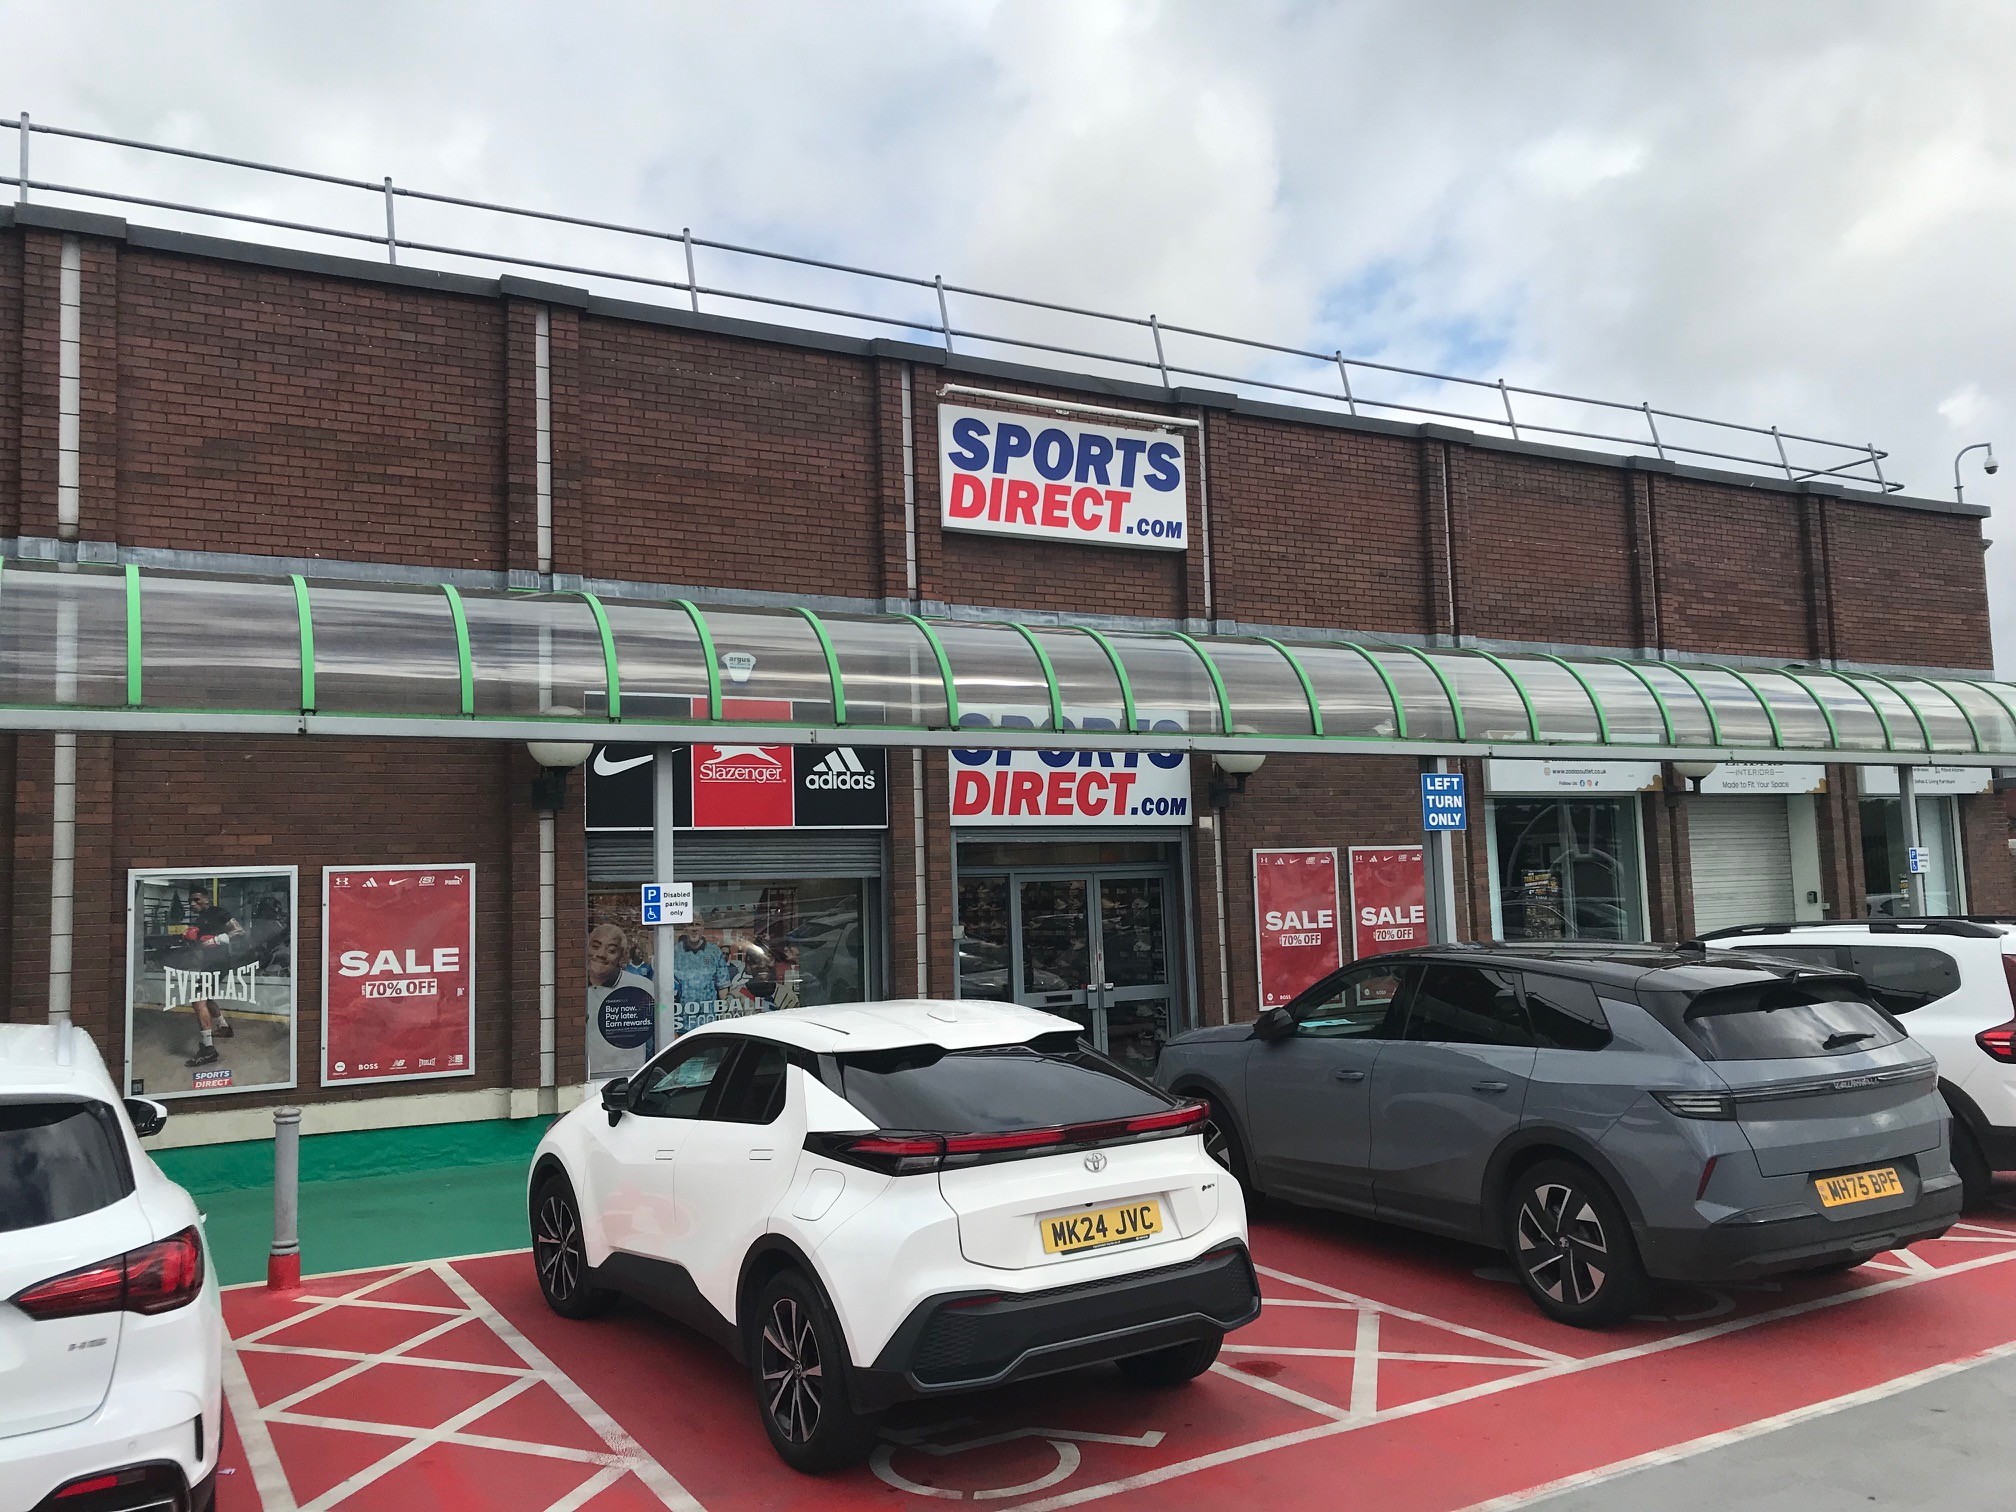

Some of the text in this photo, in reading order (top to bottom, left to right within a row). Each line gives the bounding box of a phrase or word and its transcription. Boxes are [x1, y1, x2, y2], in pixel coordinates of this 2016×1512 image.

[948, 418, 1182, 492] SPORTS
[700, 764, 782, 783] Slazenger
[805, 771, 876, 790] adidas
[1426, 777, 1460, 790] LEFT
[1722, 781, 1739, 789] Made
[1771, 781, 1789, 789] Space
[1426, 795, 1463, 808] TURN
[1429, 813, 1461, 826] ONLY
[1265, 909, 1333, 931] SALE
[1361, 905, 1425, 926] SALE
[1283, 935, 1302, 945] 70%
[1304, 934, 1321, 945] OFF
[1377, 929, 1395, 940] 70%
[1396, 928, 1413, 939] OFF
[338, 947, 460, 977] SALE
[163, 961, 260, 1012] EVERLAST
[367, 982, 402, 997] 70%
[406, 980, 436, 995] OFF
[605, 1005, 619, 1013] Buy
[605, 1013, 619, 1021] Pay
[605, 1018, 653, 1028] Earn rewards.
[358, 1062, 379, 1070] BOSS
[195, 1070, 230, 1080] SPORTS
[195, 1079, 230, 1088] DIRECT
[1827, 1175, 1870, 1201] MH75
[1868, 1171, 1898, 1194] BPF
[1051, 1206, 1154, 1248] MK24 JVC
[67, 1337, 107, 1351] HS
